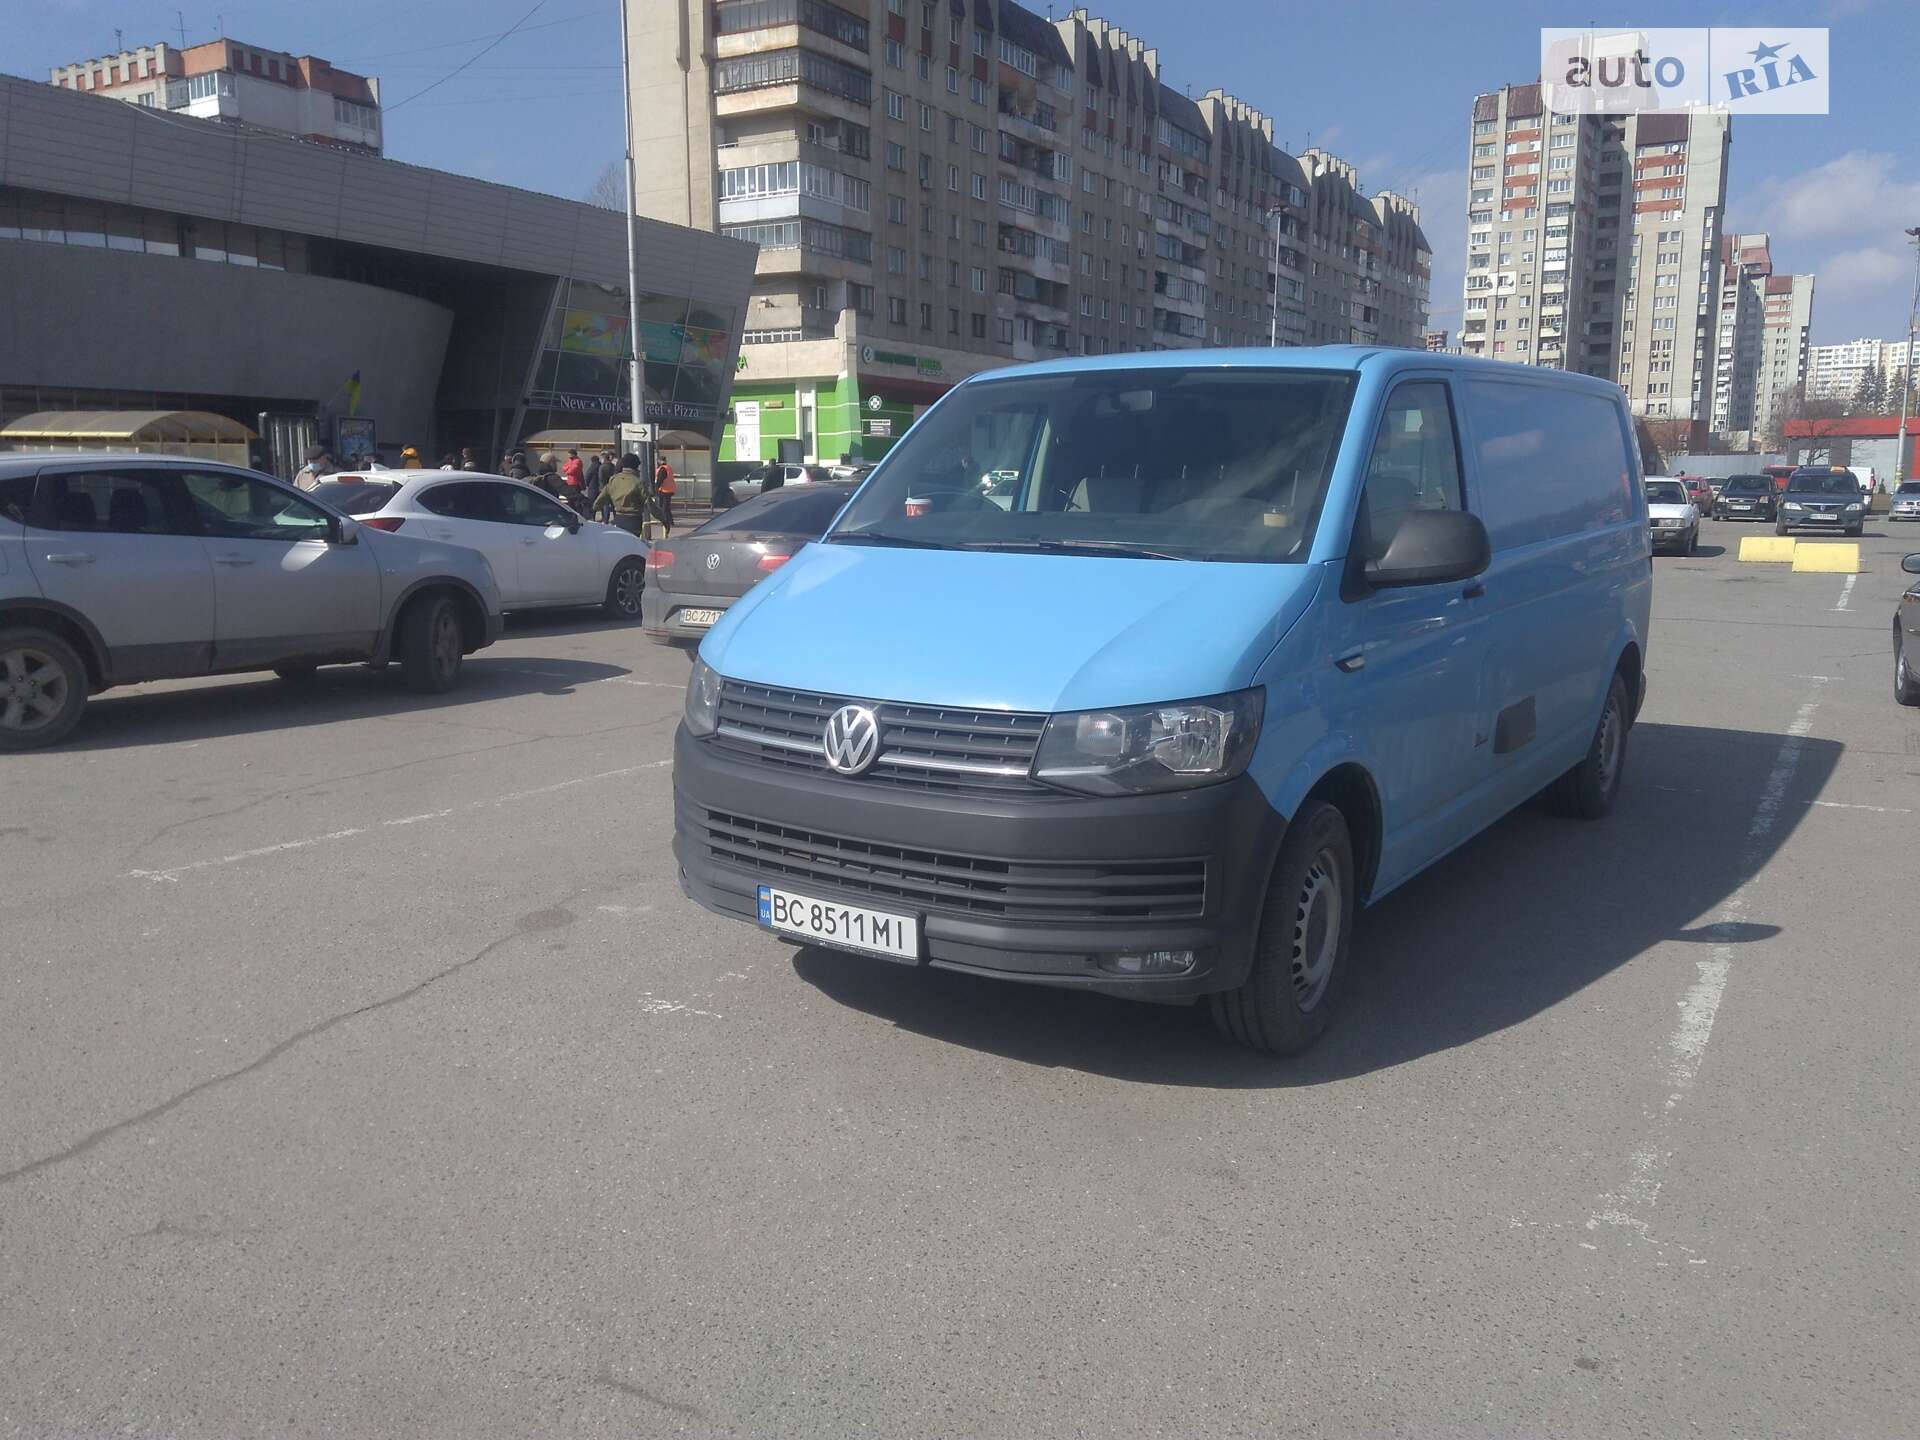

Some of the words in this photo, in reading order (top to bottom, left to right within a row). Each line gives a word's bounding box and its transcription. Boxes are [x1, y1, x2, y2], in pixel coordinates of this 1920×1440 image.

[560, 392, 586, 410] New
[599, 398, 623, 413] York
[645, 403, 664, 416] reet
[674, 404, 700, 418] Pizza
[760, 909, 771, 919] UA
[773, 894, 804, 927] BC
[810, 904, 865, 942] 8511
